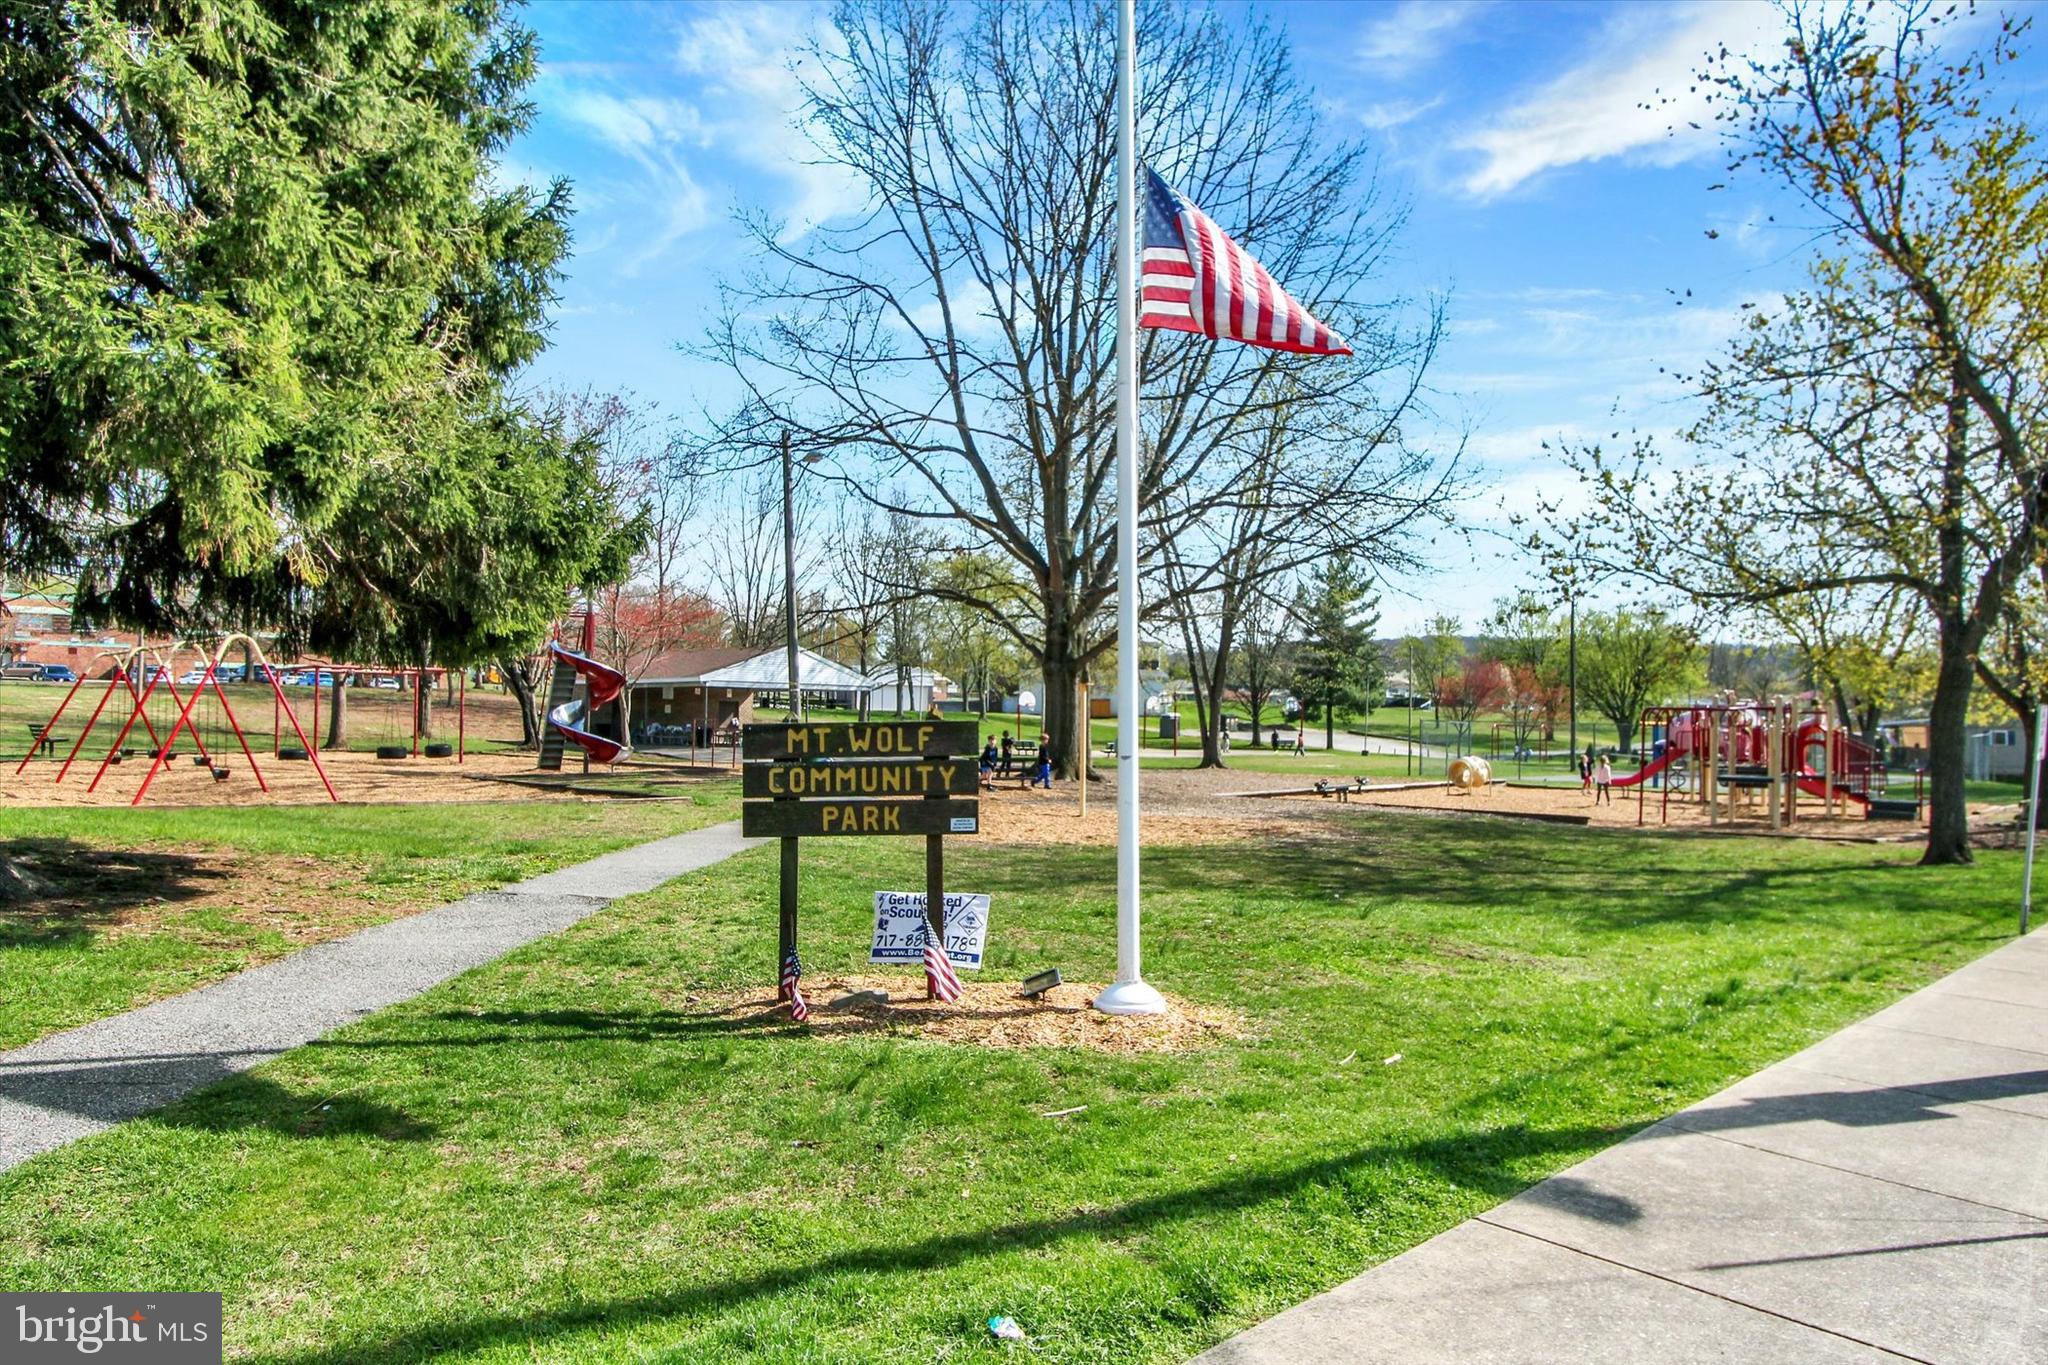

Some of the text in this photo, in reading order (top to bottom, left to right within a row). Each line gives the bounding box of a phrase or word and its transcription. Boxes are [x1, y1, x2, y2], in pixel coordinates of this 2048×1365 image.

[768, 766, 955, 793] COMMUNITY
[823, 806, 900, 831] PARK
[889, 894, 910, 905] Get
